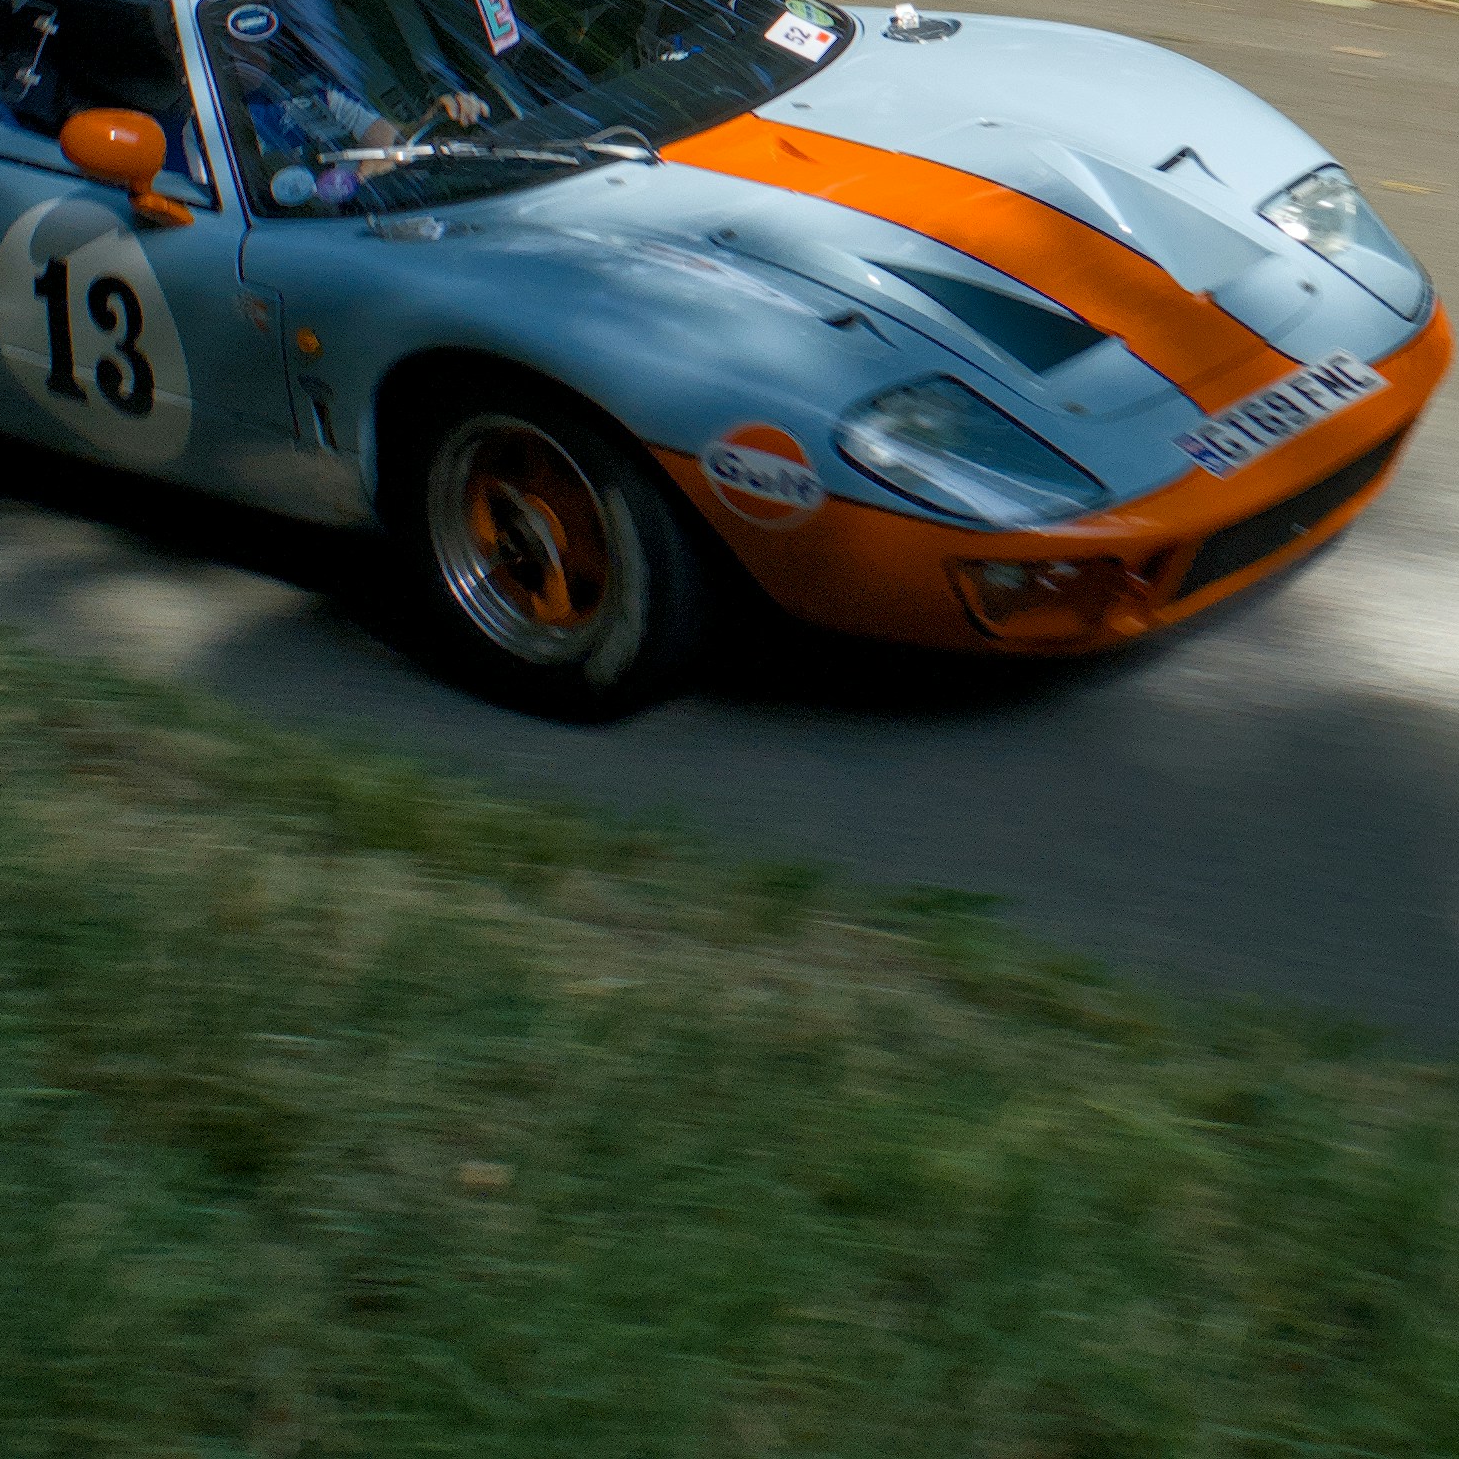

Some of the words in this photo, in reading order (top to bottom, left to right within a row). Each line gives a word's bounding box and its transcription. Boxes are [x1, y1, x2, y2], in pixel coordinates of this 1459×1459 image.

[783, 25, 811, 46] 52
[33, 255, 156, 420] 13
[1193, 389, 1314, 462] GT69
[708, 447, 813, 505] Gulf
